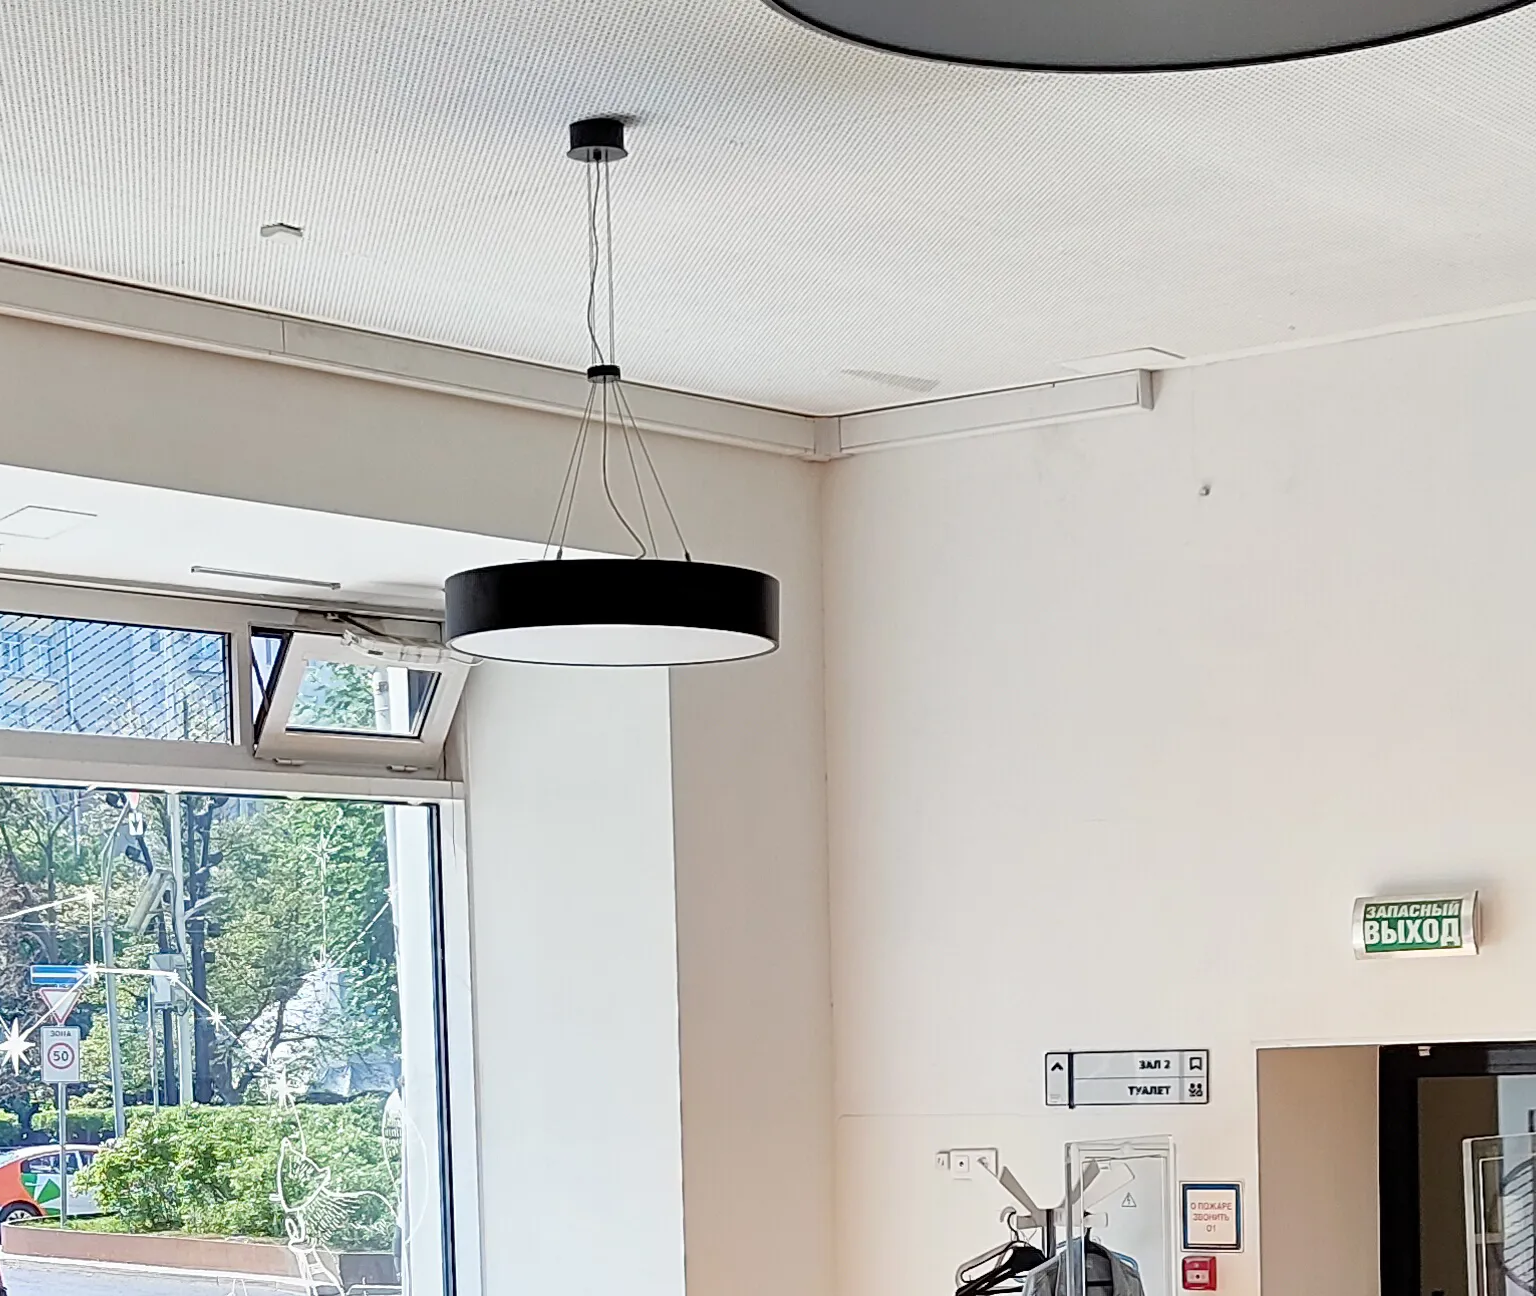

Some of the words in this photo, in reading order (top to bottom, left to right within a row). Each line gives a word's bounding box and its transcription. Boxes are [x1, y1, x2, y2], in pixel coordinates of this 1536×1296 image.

[1366, 901, 1459, 919] ЗАПАСНЫЙ
[1364, 918, 1461, 946] ВЫХОД
[53, 1050, 69, 1062] 50
[1139, 1060, 1161, 1069] ЗАЛ
[1163, 1060, 1171, 1069] 2
[1128, 1086, 1171, 1096] ТУАЛЕТ
[1191, 1202, 1197, 1210] О
[1198, 1202, 1232, 1211] ПОЖАРЕ
[1193, 1213, 1230, 1221] ЗВОНИТЬ
